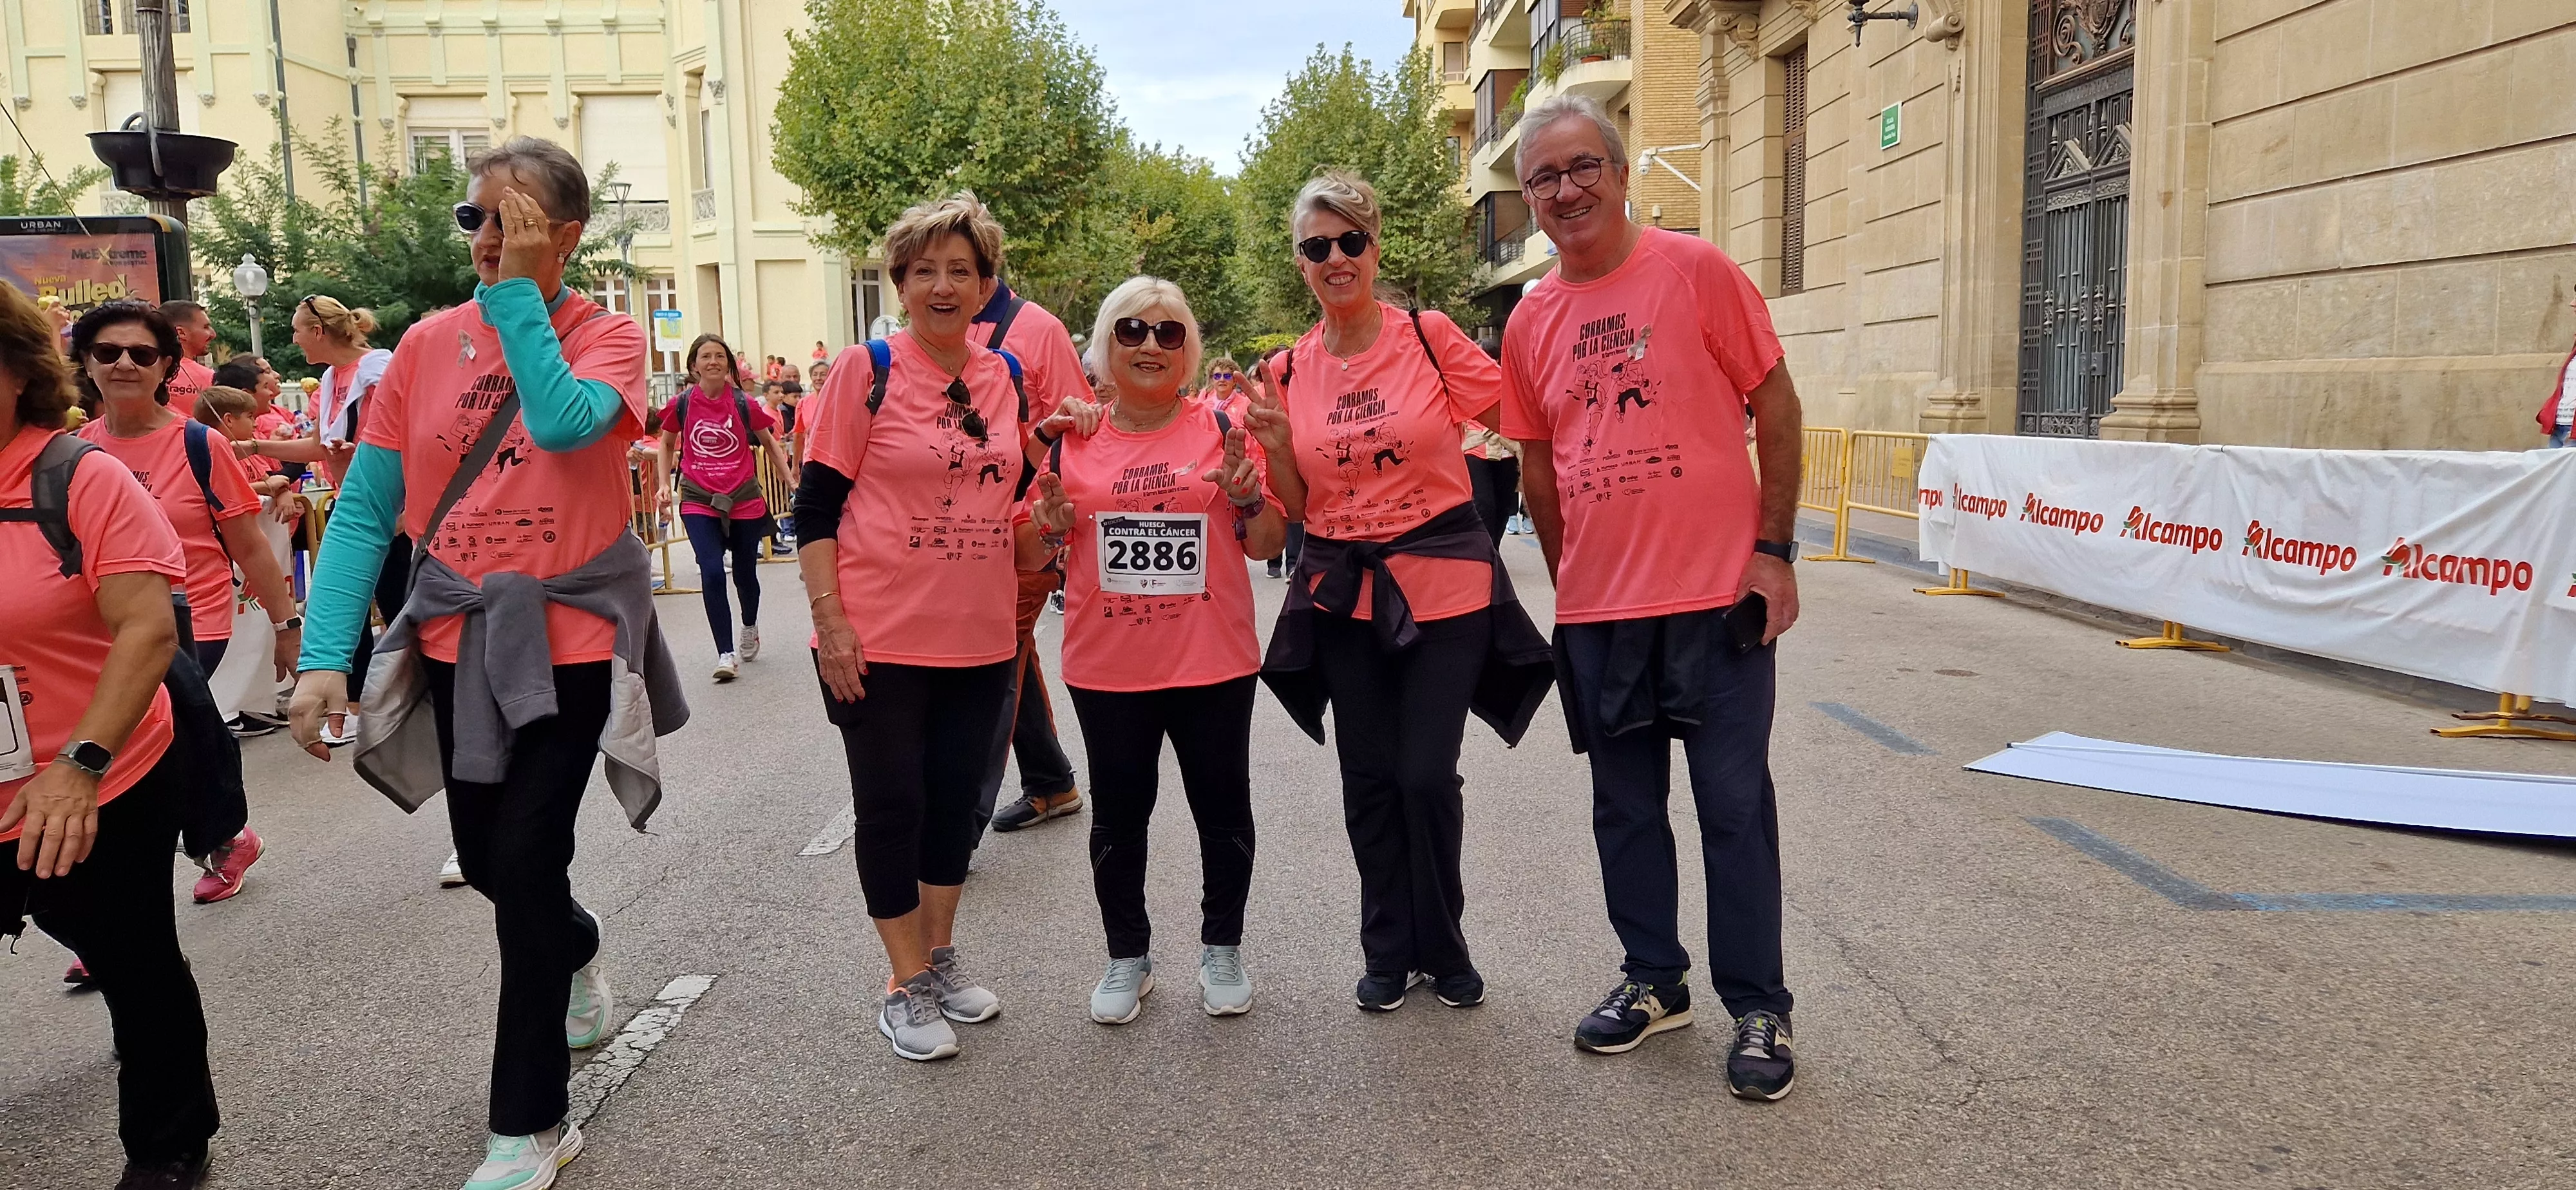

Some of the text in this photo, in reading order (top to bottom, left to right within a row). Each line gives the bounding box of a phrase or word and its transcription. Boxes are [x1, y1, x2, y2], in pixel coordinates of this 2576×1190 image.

[21, 221, 61, 229] URBAN
[1580, 312, 1626, 341] CORRAMOS
[1573, 328, 1634, 363] POR LA CIENCIA
[471, 374, 516, 393] CORRAM
[455, 392, 478, 410] POR
[478, 392, 491, 410] LA
[1327, 399, 1386, 426] POR LA CIENCIA
[1336, 388, 1379, 410] CORRAMOS
[937, 416, 952, 430] POR
[1112, 473, 1176, 496] POR LA CIENCIA
[1122, 462, 1170, 481] CORRAMOS
[1953, 482, 2007, 520] Alcampo
[2020, 492, 2104, 536] Alcampo
[1109, 528, 1146, 536] CONTRA
[1160, 527, 1196, 536] CÁNCER
[2119, 505, 2222, 554] Alcampo
[1108, 540, 1197, 571] 2886
[2242, 519, 2357, 576] Alcampo
[2381, 536, 2533, 596] Alcampo
